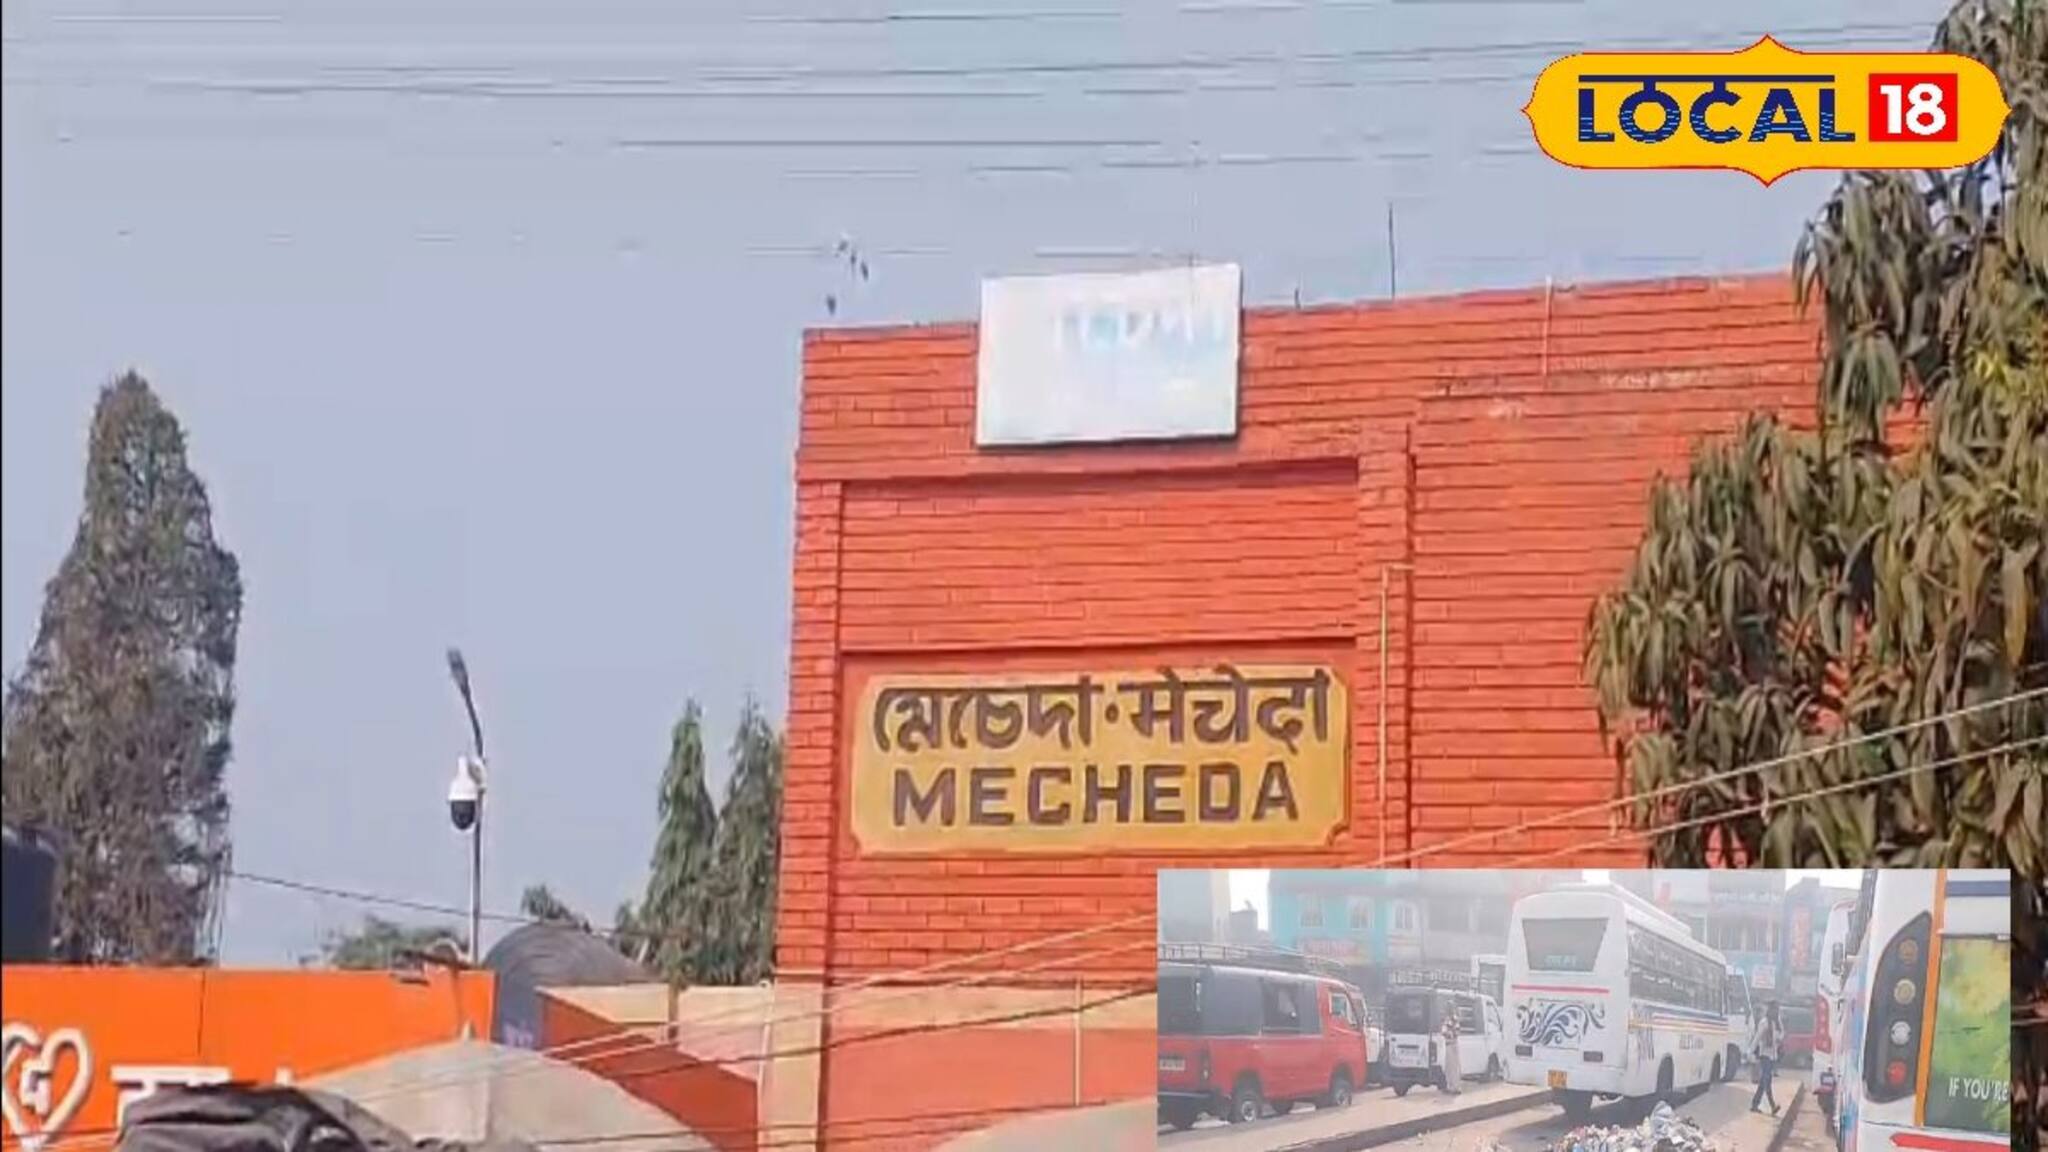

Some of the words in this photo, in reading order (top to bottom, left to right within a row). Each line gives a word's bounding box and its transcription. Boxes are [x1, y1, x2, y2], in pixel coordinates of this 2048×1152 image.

[873, 675, 1104, 752] মেচেদা
[1117, 664, 1331, 754] मेचेदा
[893, 760, 1300, 827] MECHEDA
[1948, 1076, 1960, 1097] IF
